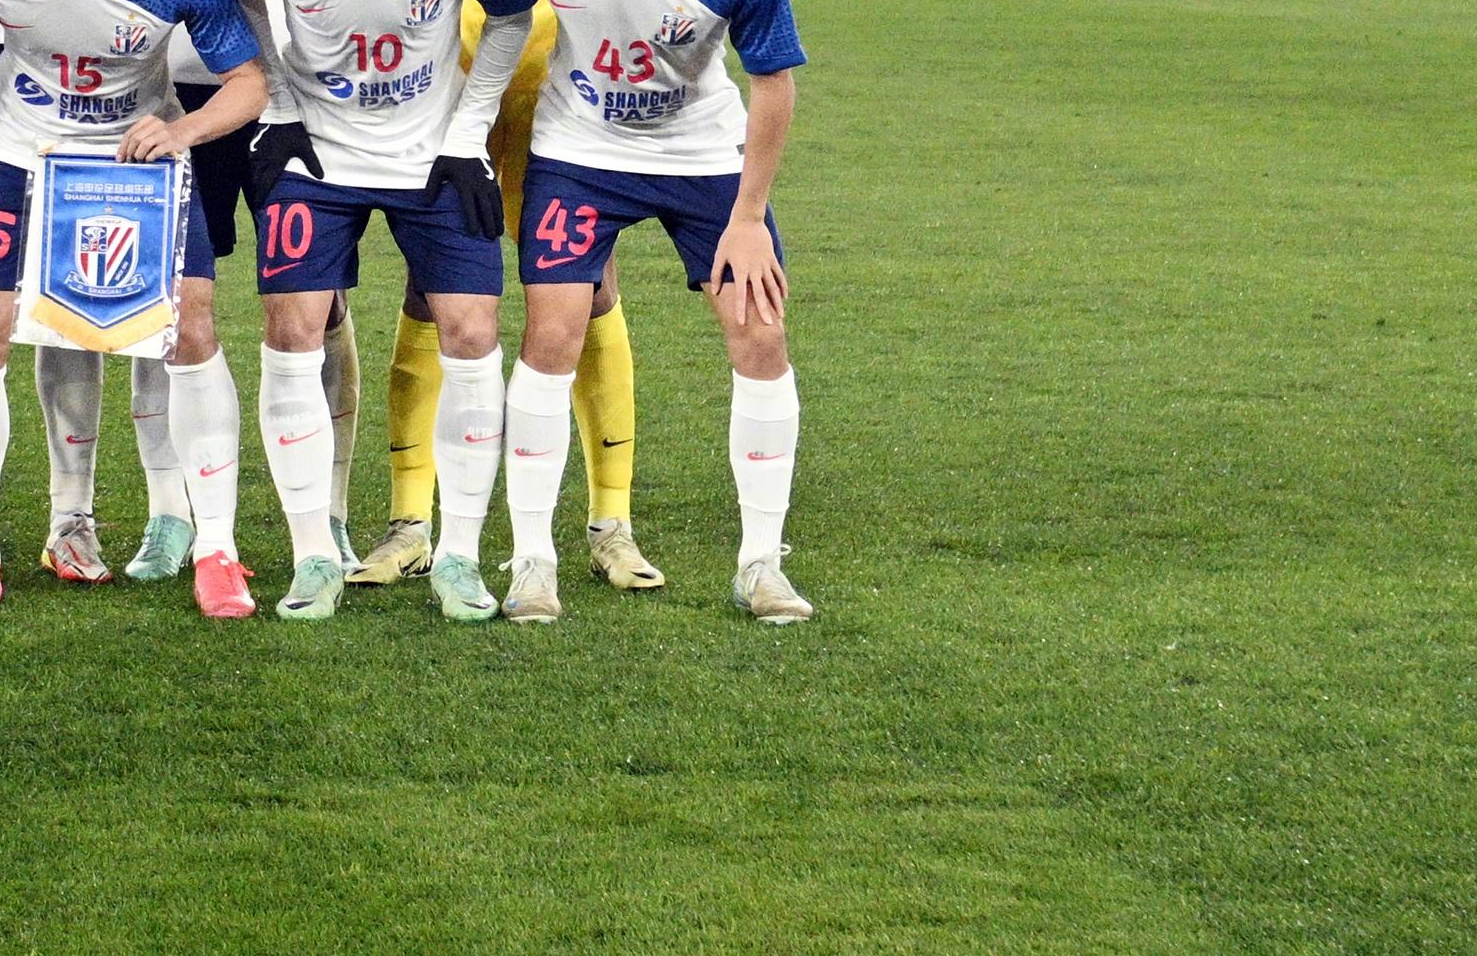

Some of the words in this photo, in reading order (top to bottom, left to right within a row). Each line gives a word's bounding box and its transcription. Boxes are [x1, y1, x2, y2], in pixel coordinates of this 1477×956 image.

[349, 32, 403, 73] 10
[592, 37, 655, 84] 43
[51, 53, 103, 93] 15
[359, 60, 434, 97] SHANGHAI
[359, 77, 432, 108] PASS
[604, 85, 686, 109] SHANGHAI
[604, 100, 684, 122] PASS
[265, 201, 313, 260] 10
[535, 198, 599, 257] 43
